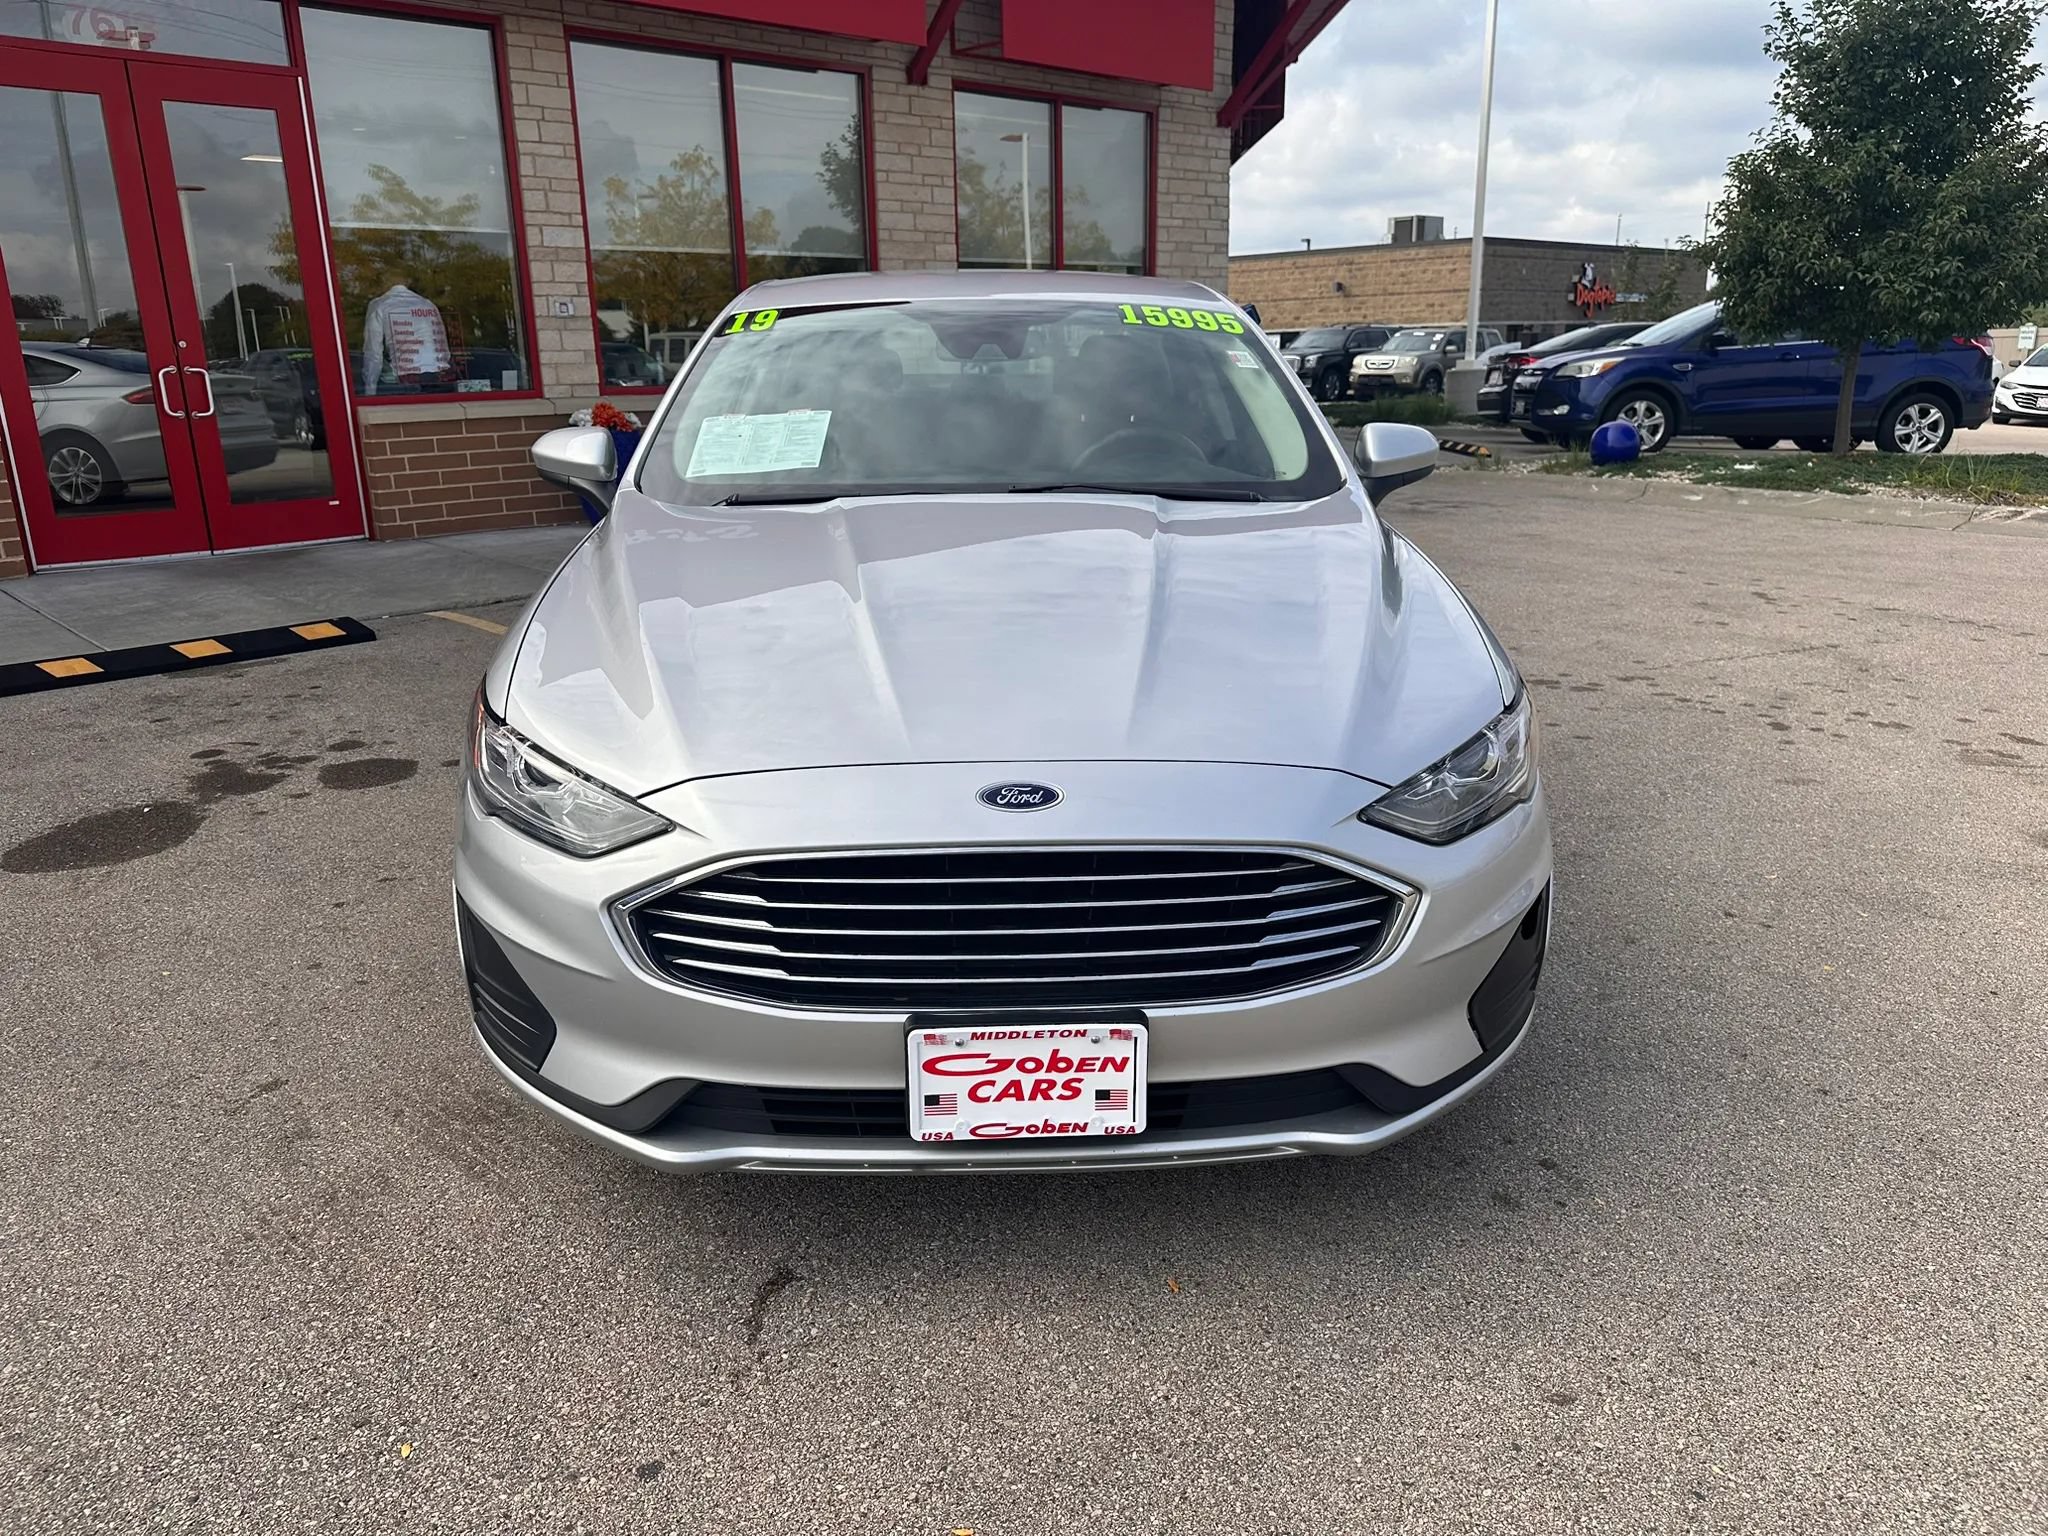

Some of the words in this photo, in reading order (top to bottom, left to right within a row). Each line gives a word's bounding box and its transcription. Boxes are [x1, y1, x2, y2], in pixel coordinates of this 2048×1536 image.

[410, 308, 439, 318] HOURS
[1118, 303, 1245, 335] 15995
[725, 309, 779, 334] 19
[996, 786, 1044, 805] Ford
[970, 1029, 1089, 1041] MIDDLETON
[967, 1077, 1085, 1104] CARS
[921, 1131, 954, 1142] USA
[1103, 1125, 1136, 1135] USA
